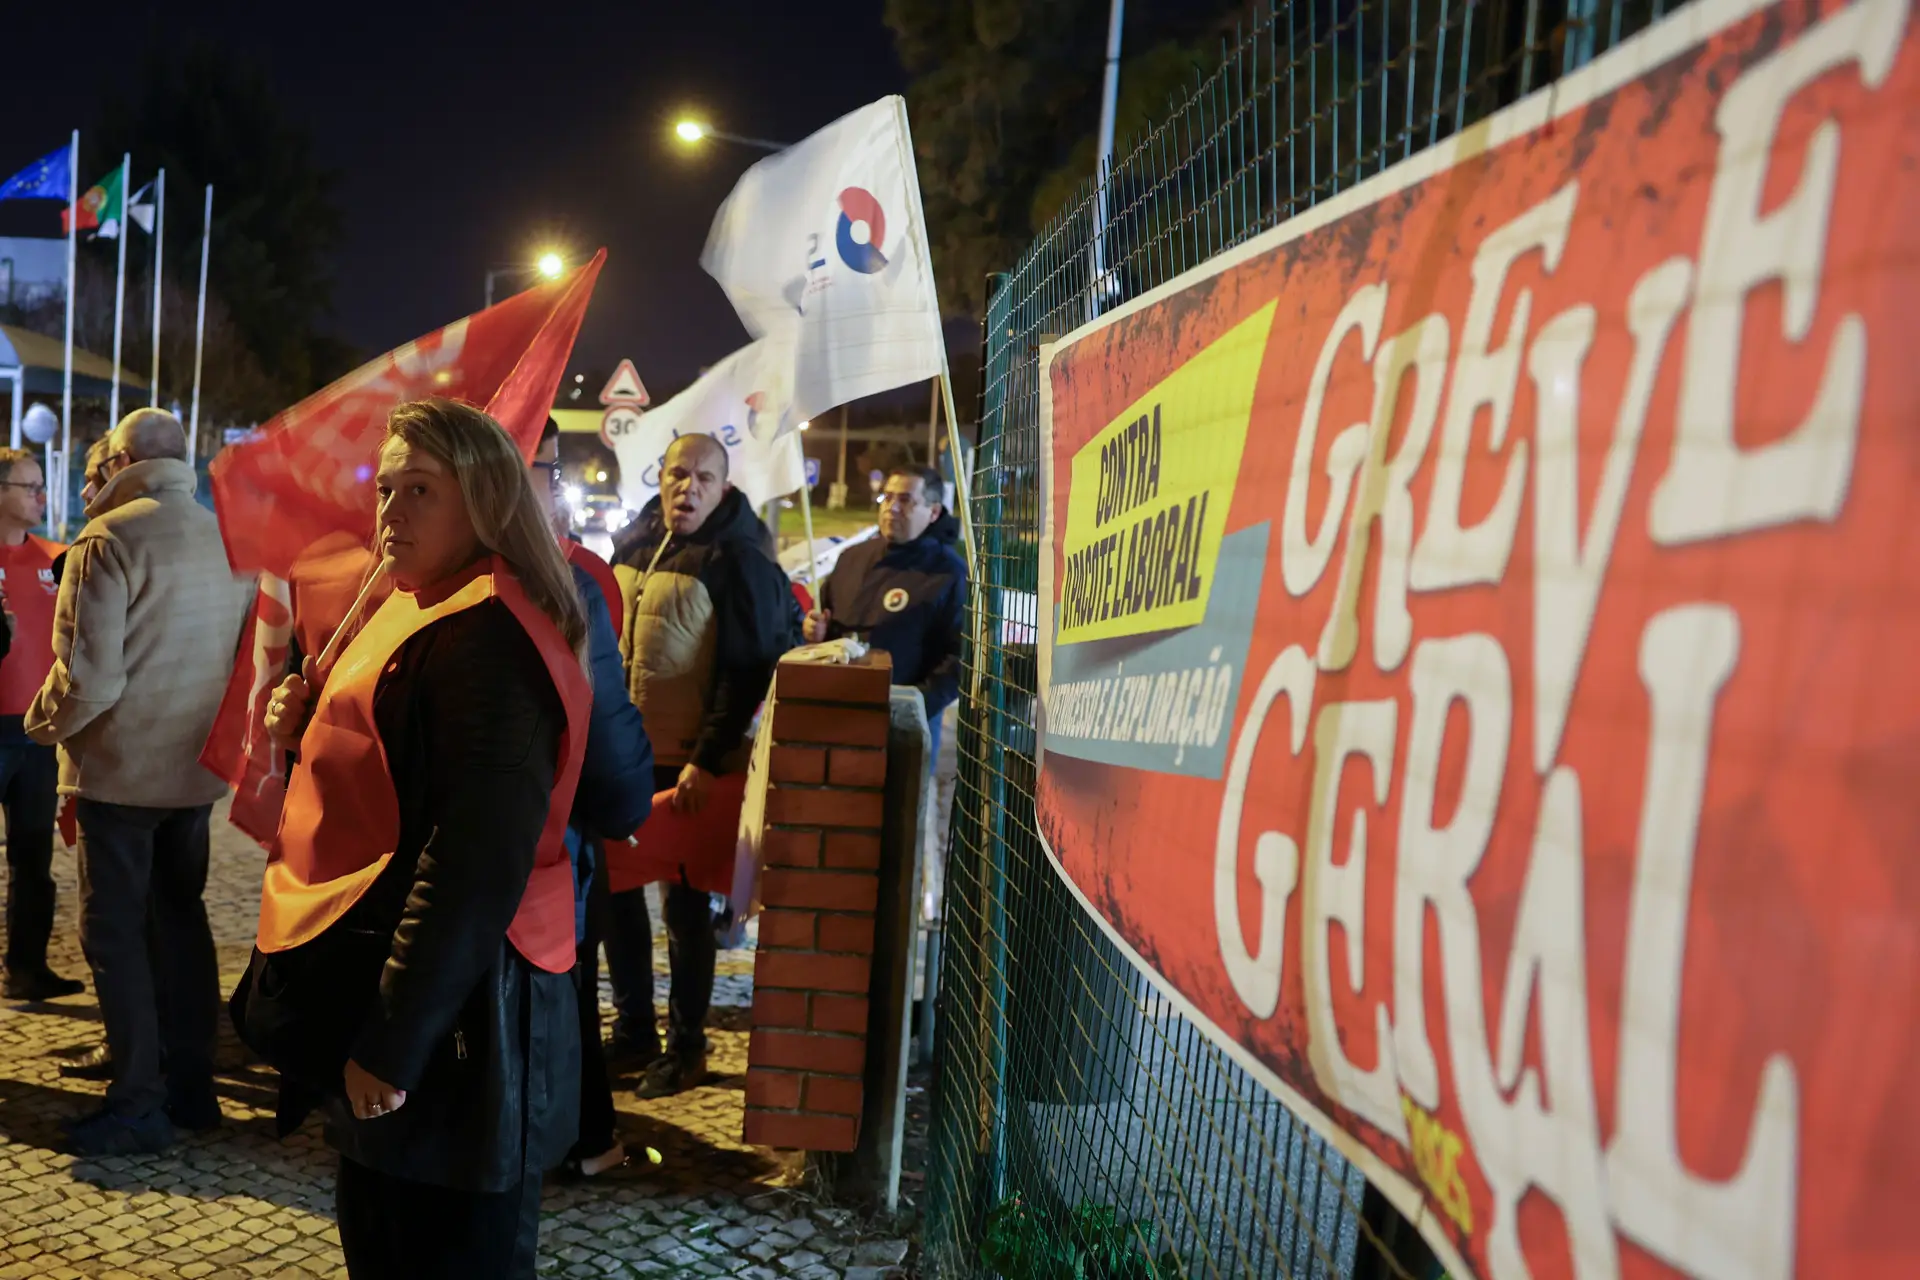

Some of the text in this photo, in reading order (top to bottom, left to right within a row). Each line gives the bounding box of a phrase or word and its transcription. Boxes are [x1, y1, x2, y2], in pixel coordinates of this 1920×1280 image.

[1281, 0, 1907, 774] GREVE
[1095, 403, 1161, 529] CONTRA
[1067, 532, 1118, 630] PACOTE
[1110, 488, 1210, 620] LABORAL
[1110, 644, 1233, 767] EXPLORAÇÃO
[1214, 602, 1799, 1280] GERAL
